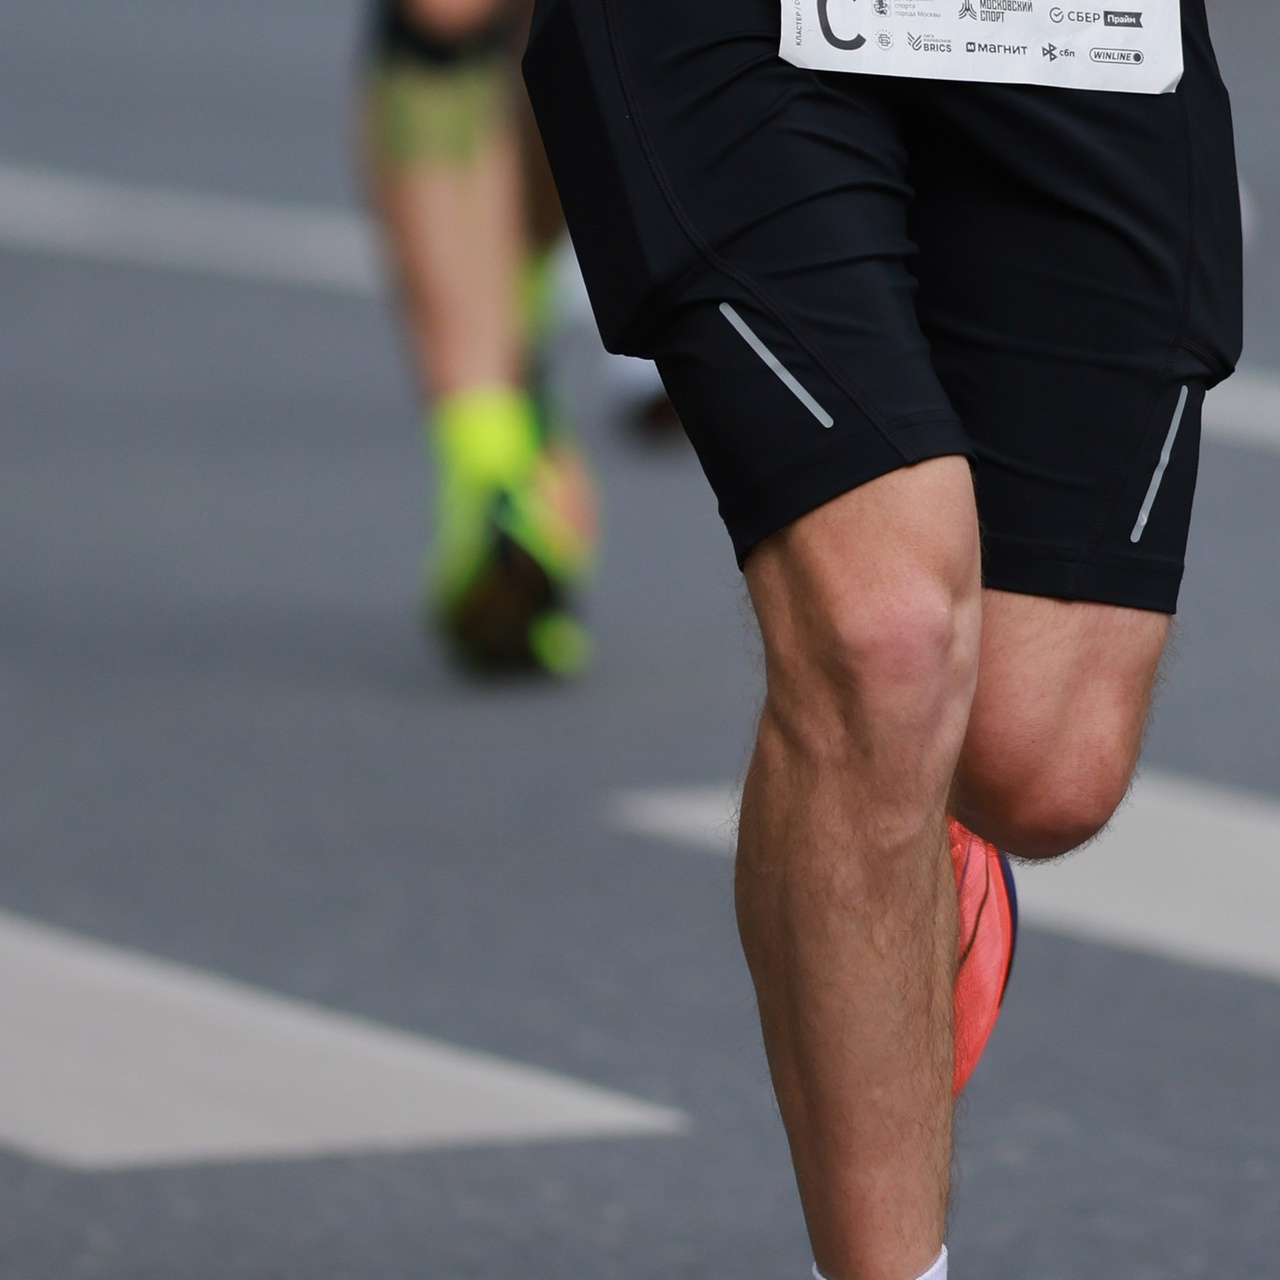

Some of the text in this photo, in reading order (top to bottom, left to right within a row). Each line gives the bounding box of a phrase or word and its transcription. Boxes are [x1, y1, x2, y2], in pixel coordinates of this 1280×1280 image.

[980, 10, 1006, 23] СПОРТ
[1067, 10, 1136, 25] СБЕР Прайм
[923, 43, 952, 53] BRICS
[1093, 51, 1132, 61] WINLINE
